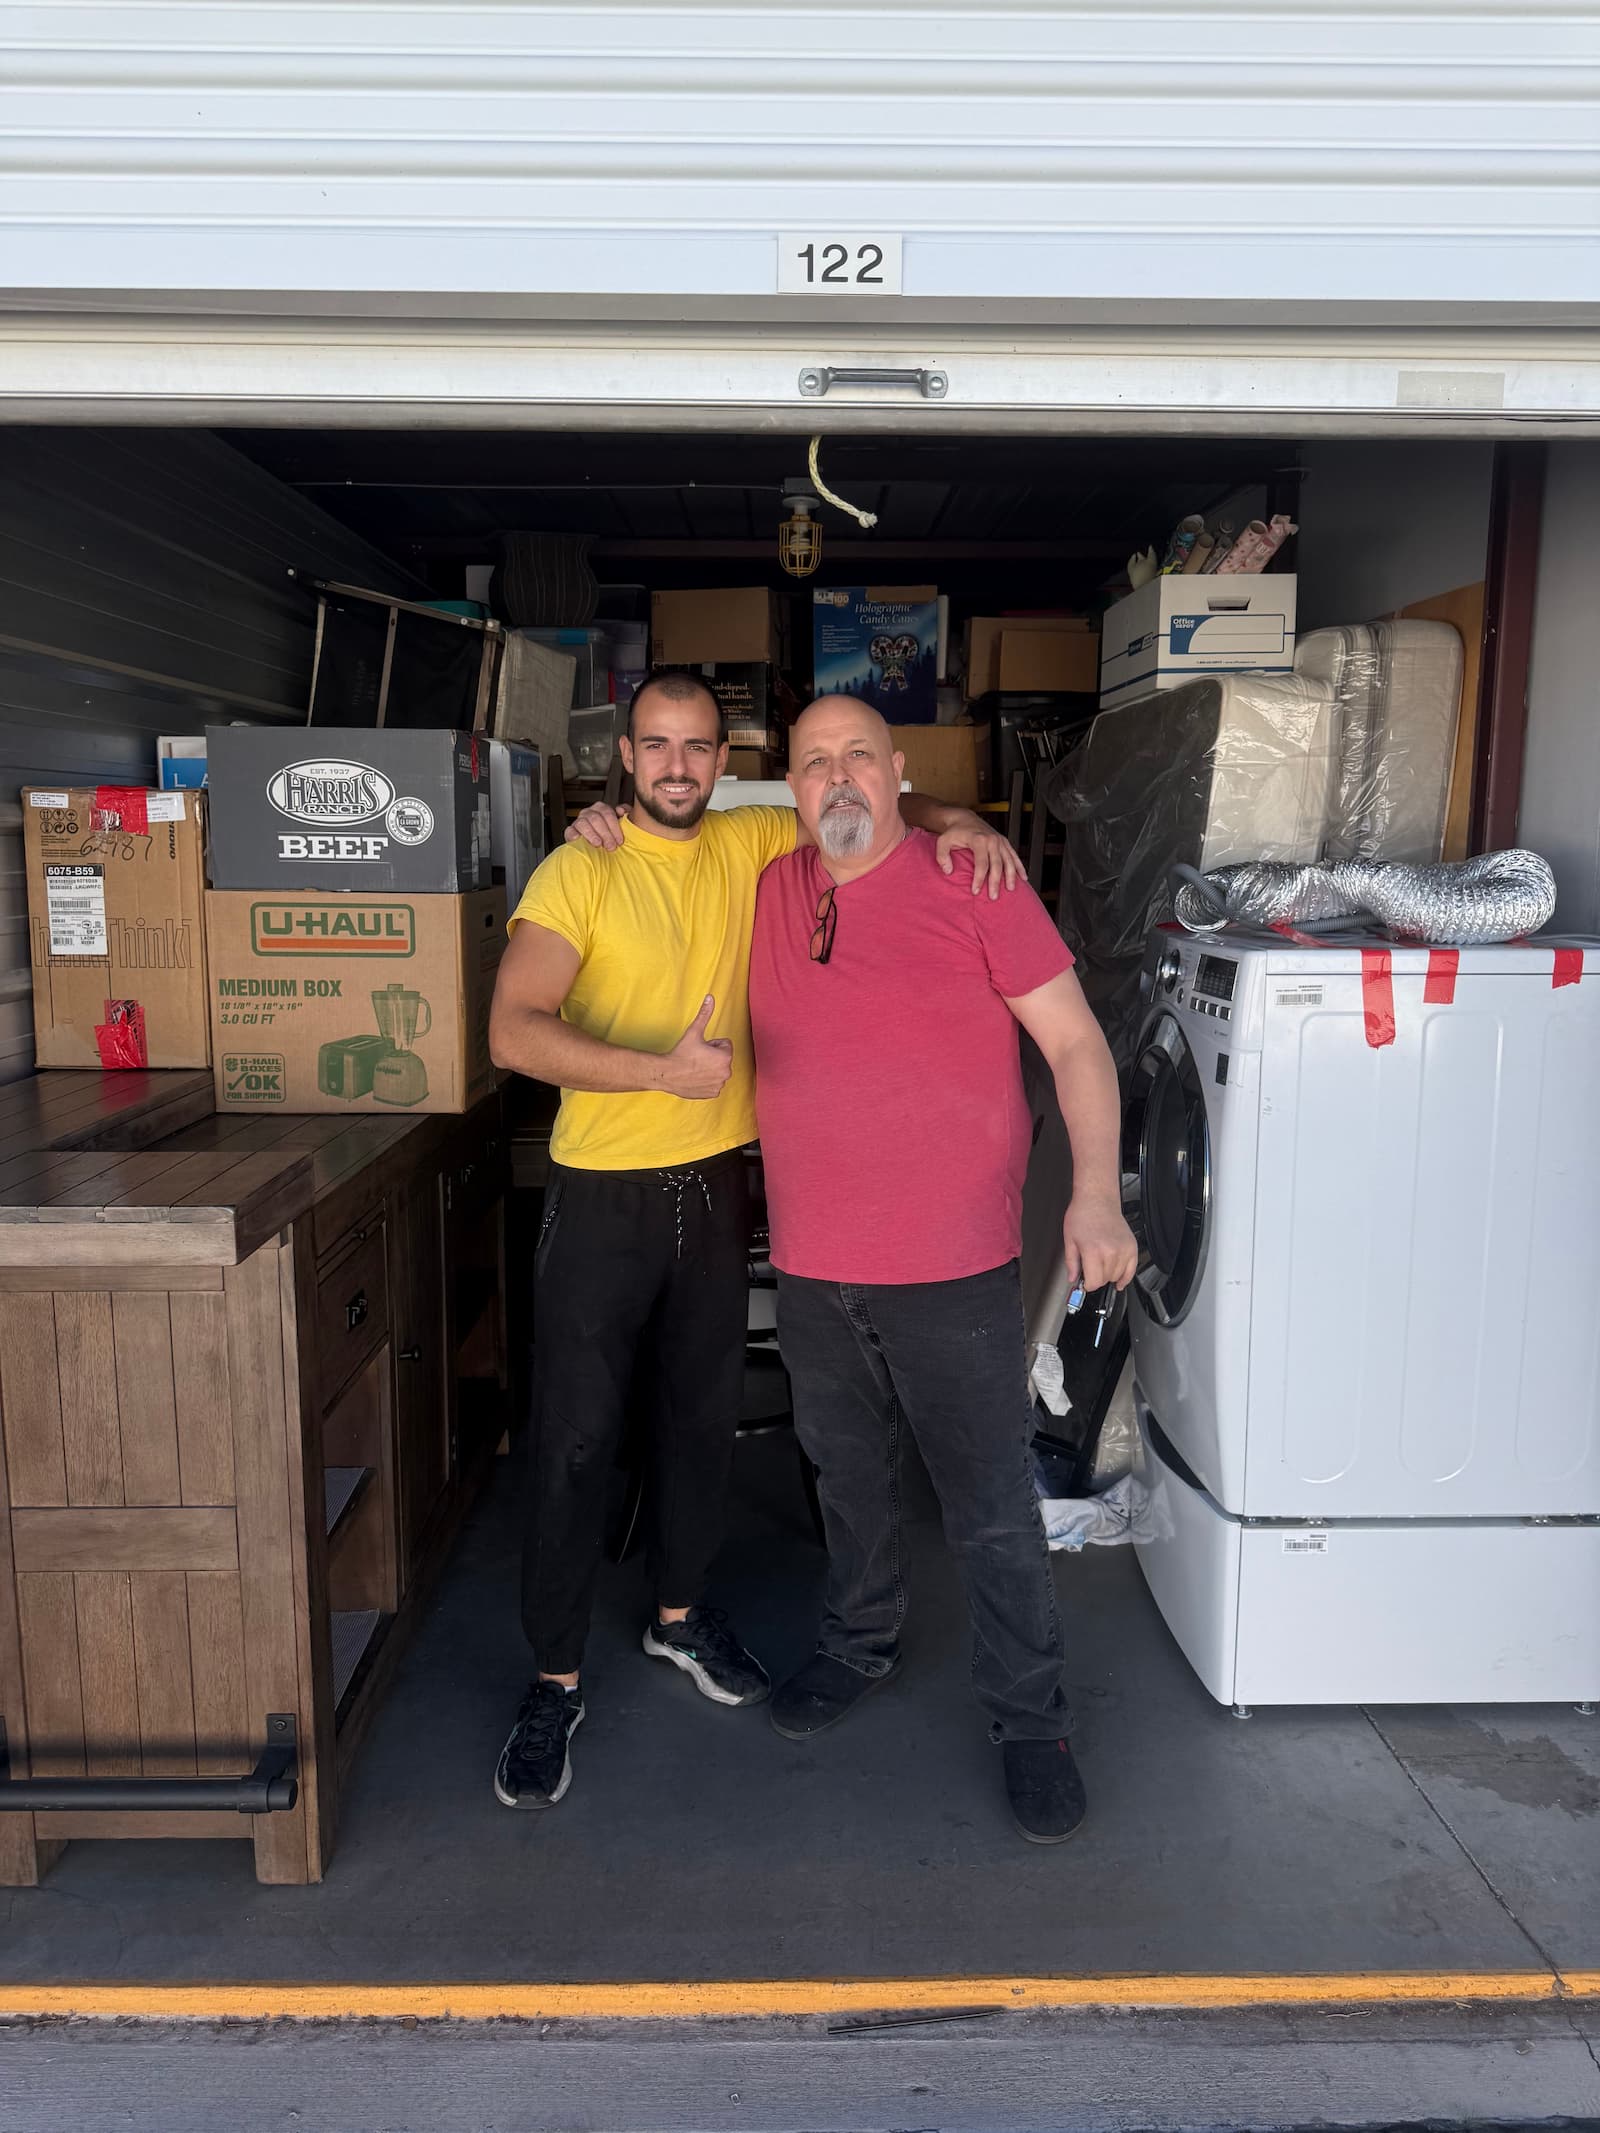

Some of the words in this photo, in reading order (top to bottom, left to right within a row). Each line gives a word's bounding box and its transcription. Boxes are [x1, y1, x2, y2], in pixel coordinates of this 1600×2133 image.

[797, 243, 883, 283] 122
[855, 603, 913, 614] Holographic
[859, 614, 890, 625] Candy
[282, 768, 380, 813] HARRIS
[307, 805, 362, 814] RANCH
[278, 835, 389, 860] BEEF
[47, 866, 94, 876] 6075-B59
[262, 911, 405, 936] U-HAUL
[218, 979, 297, 997] MEDIUM
[304, 979, 343, 997] BOX
[220, 1002, 231, 1010] 18
[278, 1003, 284, 1011] x
[220, 1014, 239, 1025] 3.0
[242, 1014, 258, 1025] CU
[261, 1014, 276, 1025] FT
[240, 1057, 282, 1065] U-HAUL
[245, 1074, 281, 1091] OK
[226, 1092, 242, 1100] FOR
[244, 1092, 282, 1100] SHIPPING
